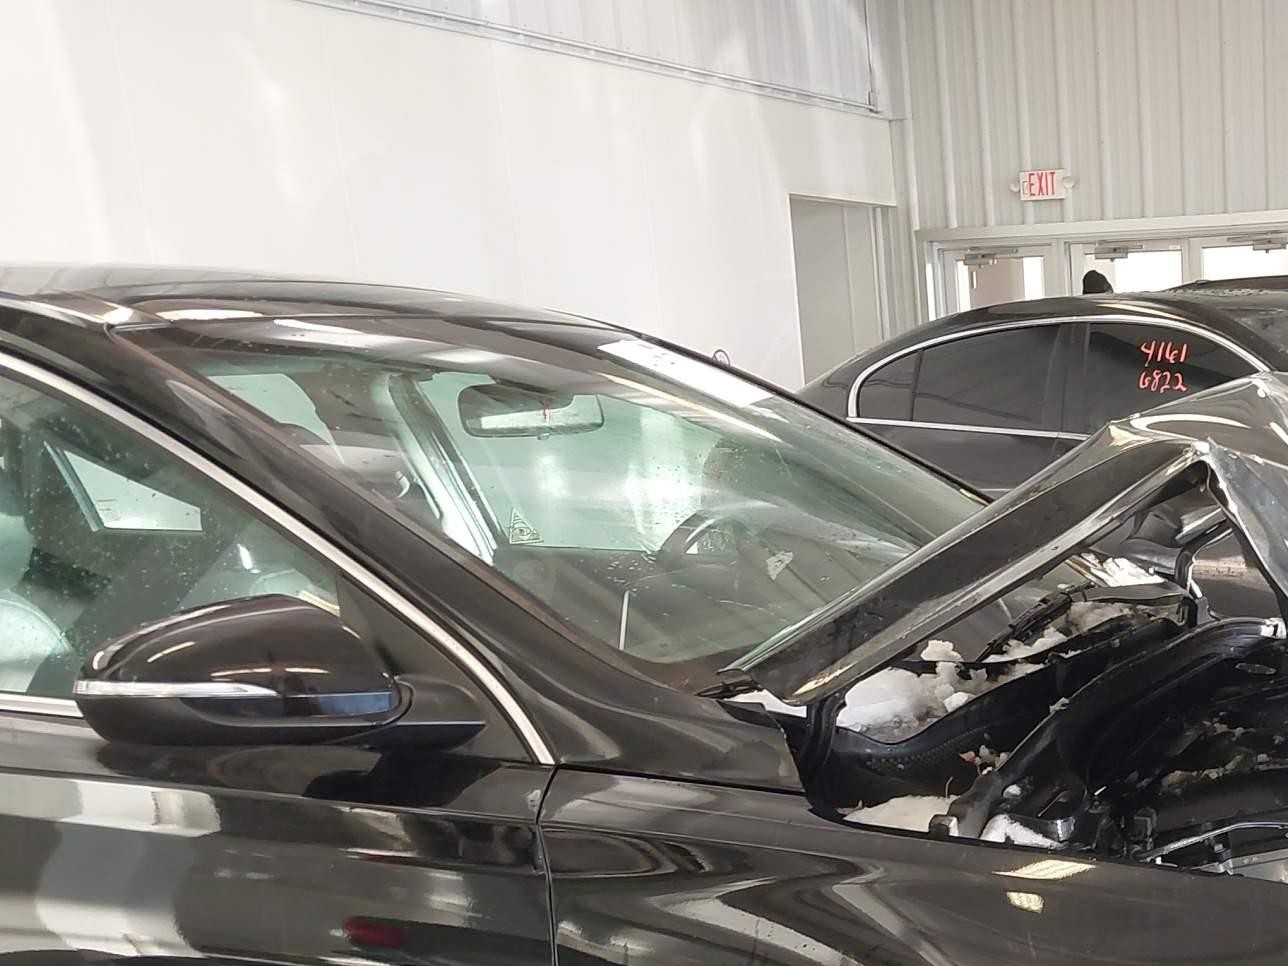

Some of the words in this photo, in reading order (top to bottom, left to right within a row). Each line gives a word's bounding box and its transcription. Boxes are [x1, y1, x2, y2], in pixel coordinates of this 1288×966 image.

[1028, 171, 1056, 197] EXIT
[1140, 340, 1188, 367] 4161
[1139, 369, 1188, 394] 6822
